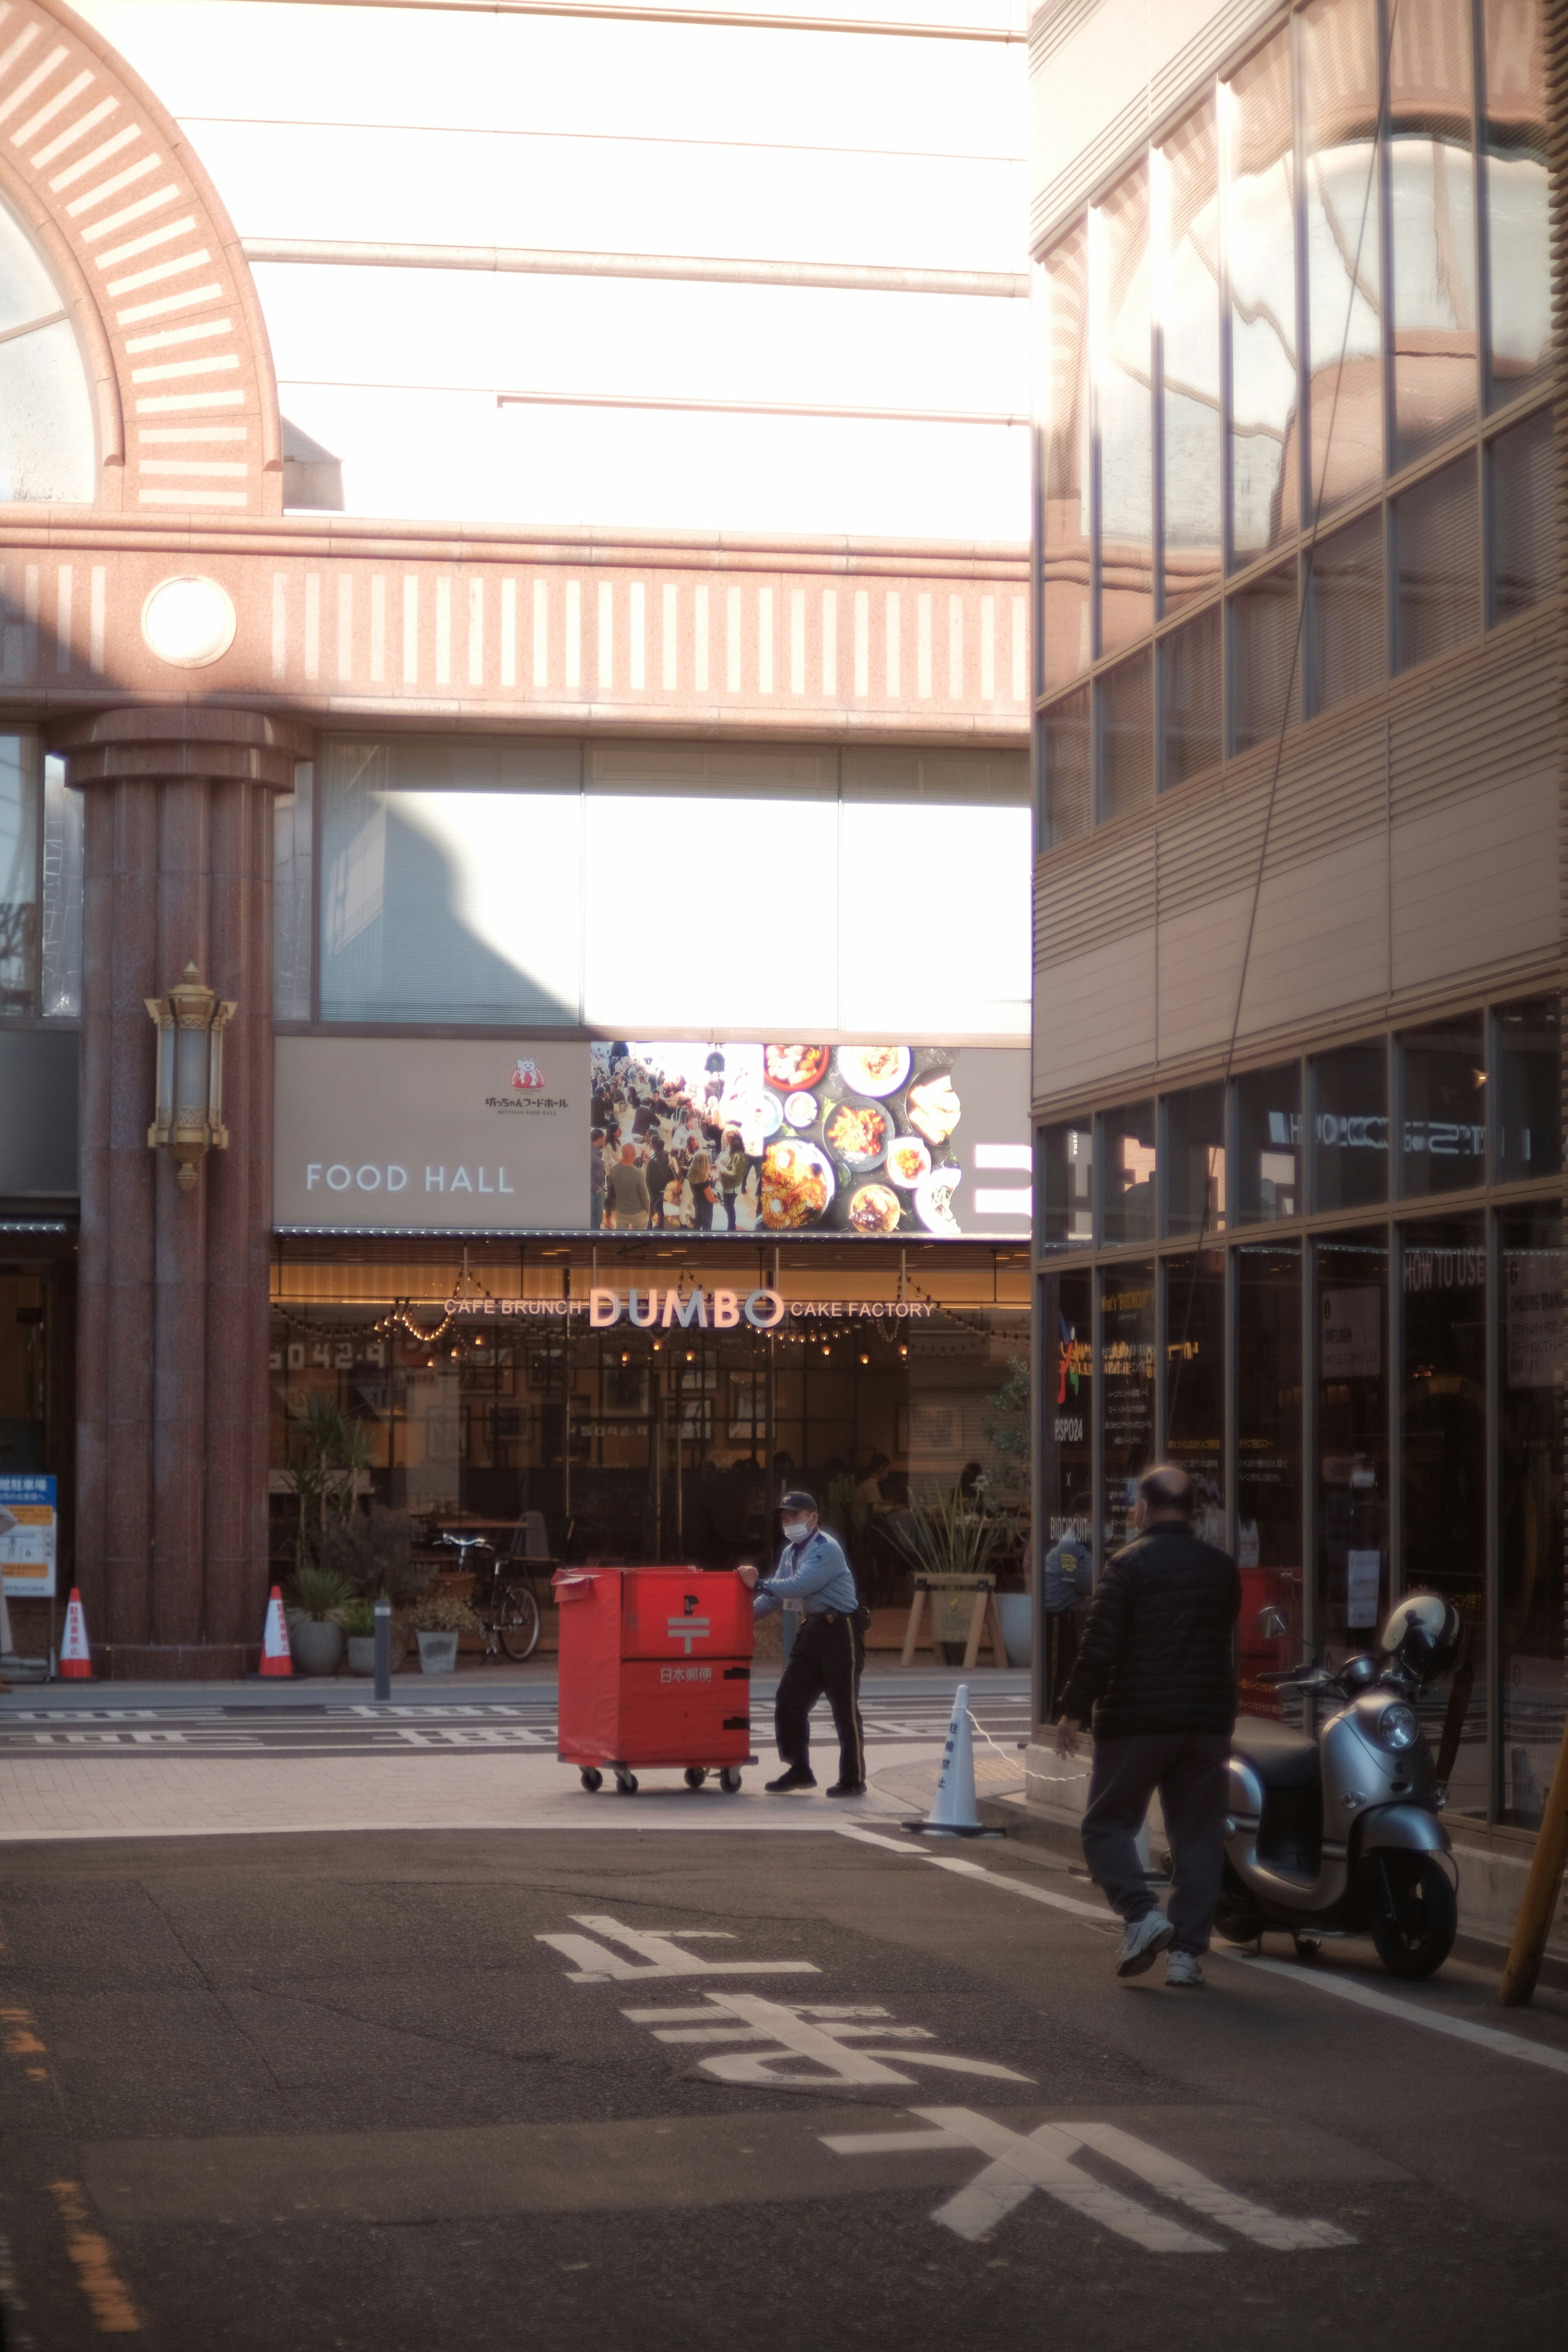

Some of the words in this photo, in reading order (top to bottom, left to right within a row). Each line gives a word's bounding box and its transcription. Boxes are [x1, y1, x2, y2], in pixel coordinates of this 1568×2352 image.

[485, 1097, 569, 1108] 坊っちゃんフードホール
[306, 1163, 407, 1192] FOOD
[425, 1166, 514, 1193] HALL
[1403, 1252, 1434, 1291] HOW
[1436, 1248, 1454, 1288] TO
[1457, 1245, 1486, 1287] USE
[444, 1298, 496, 1315] CAFE
[501, 1299, 581, 1315] BRUNCH
[590, 1288, 785, 1329] DUMBO
[791, 1302, 843, 1318] CAKE
[848, 1303, 936, 1318] FACTORY
[1101, 1293, 1117, 1312] What's
[1510, 1294, 1539, 1312] ONGOING
[1325, 1328, 1339, 1344] ONE
[1050, 1516, 1088, 1542] BIOCIRCUIT
[660, 1667, 712, 1683] 日本郵便
[937, 1722, 959, 1789] 駐輪禁止
[533, 1915, 1359, 2253] 止まれ
